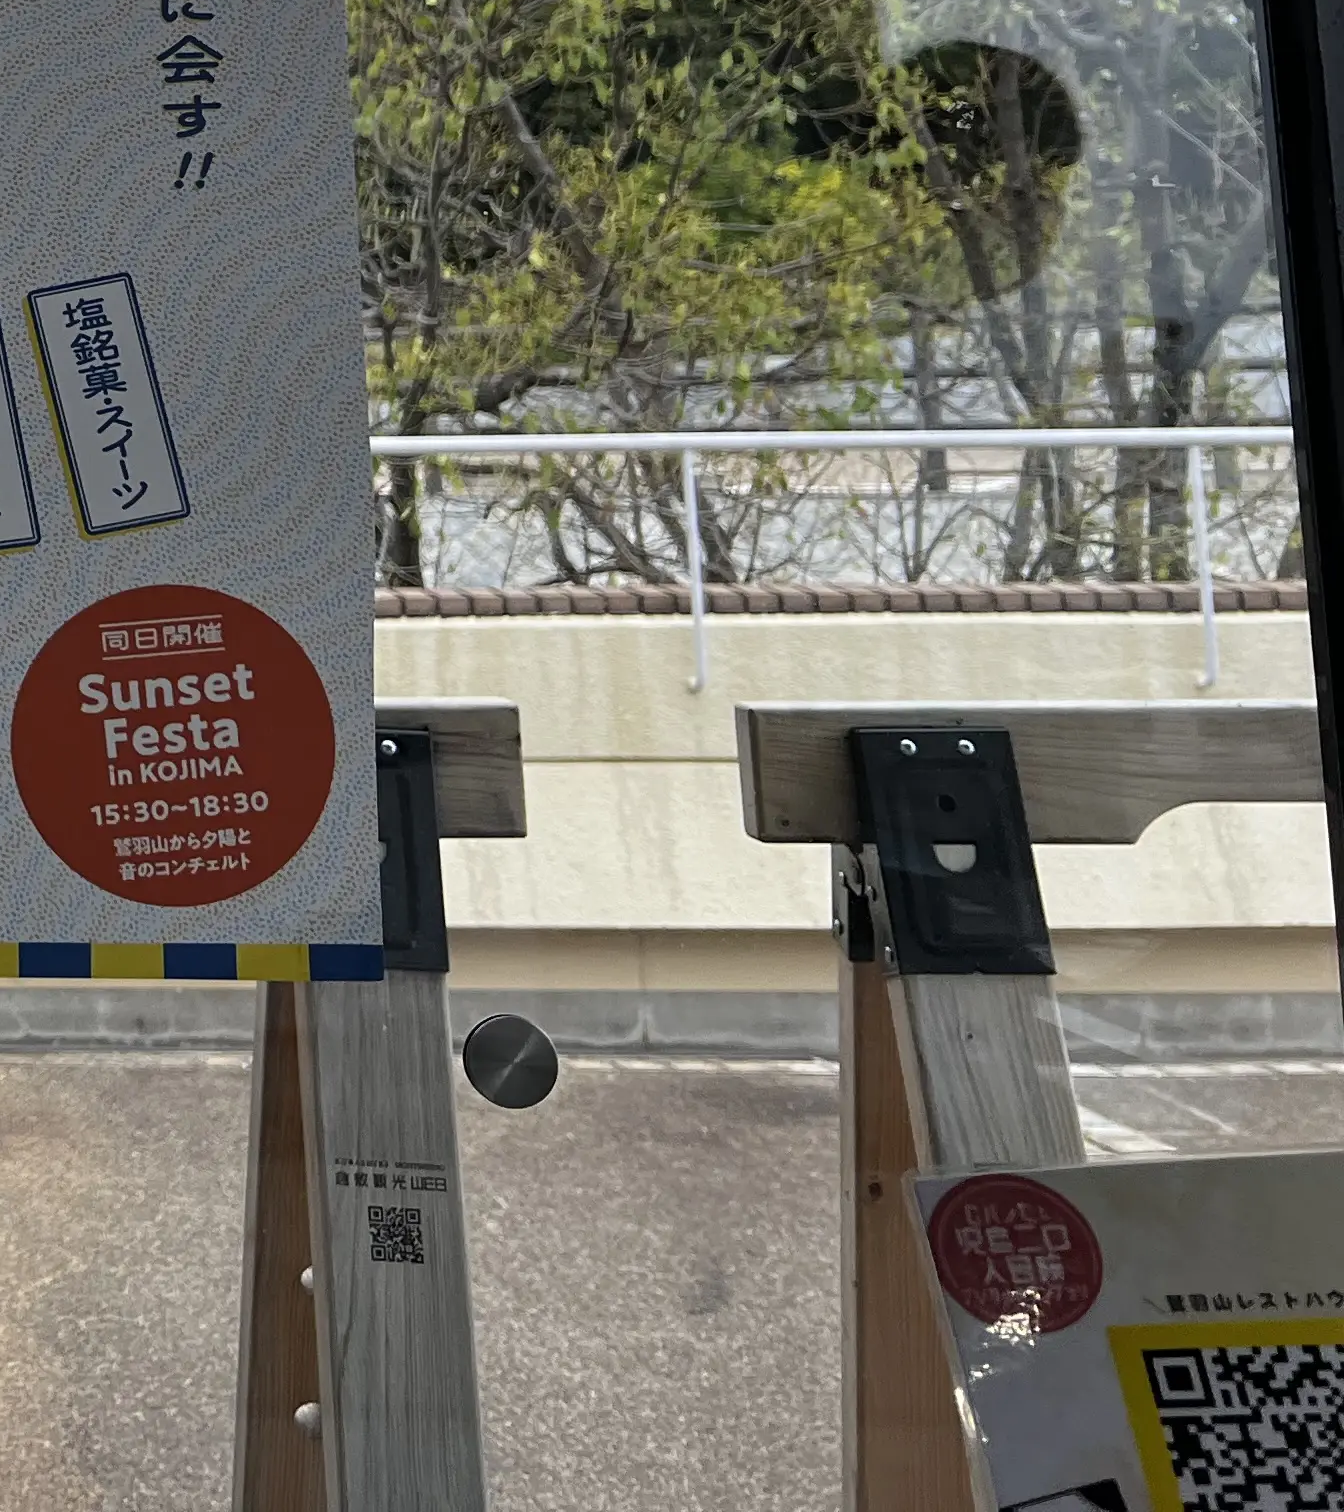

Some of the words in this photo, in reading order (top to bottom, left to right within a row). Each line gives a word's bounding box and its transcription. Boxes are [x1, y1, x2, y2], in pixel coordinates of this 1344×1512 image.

[100, 621, 224, 653] 同日開催
[77, 662, 256, 715] Sunset
[103, 713, 241, 760] Festa
[108, 764, 134, 787] in
[139, 754, 244, 784] KOJIMA
[112, 827, 253, 858] 鷲羽山から夕陽と
[118, 851, 252, 882] 音のコンチェルト
